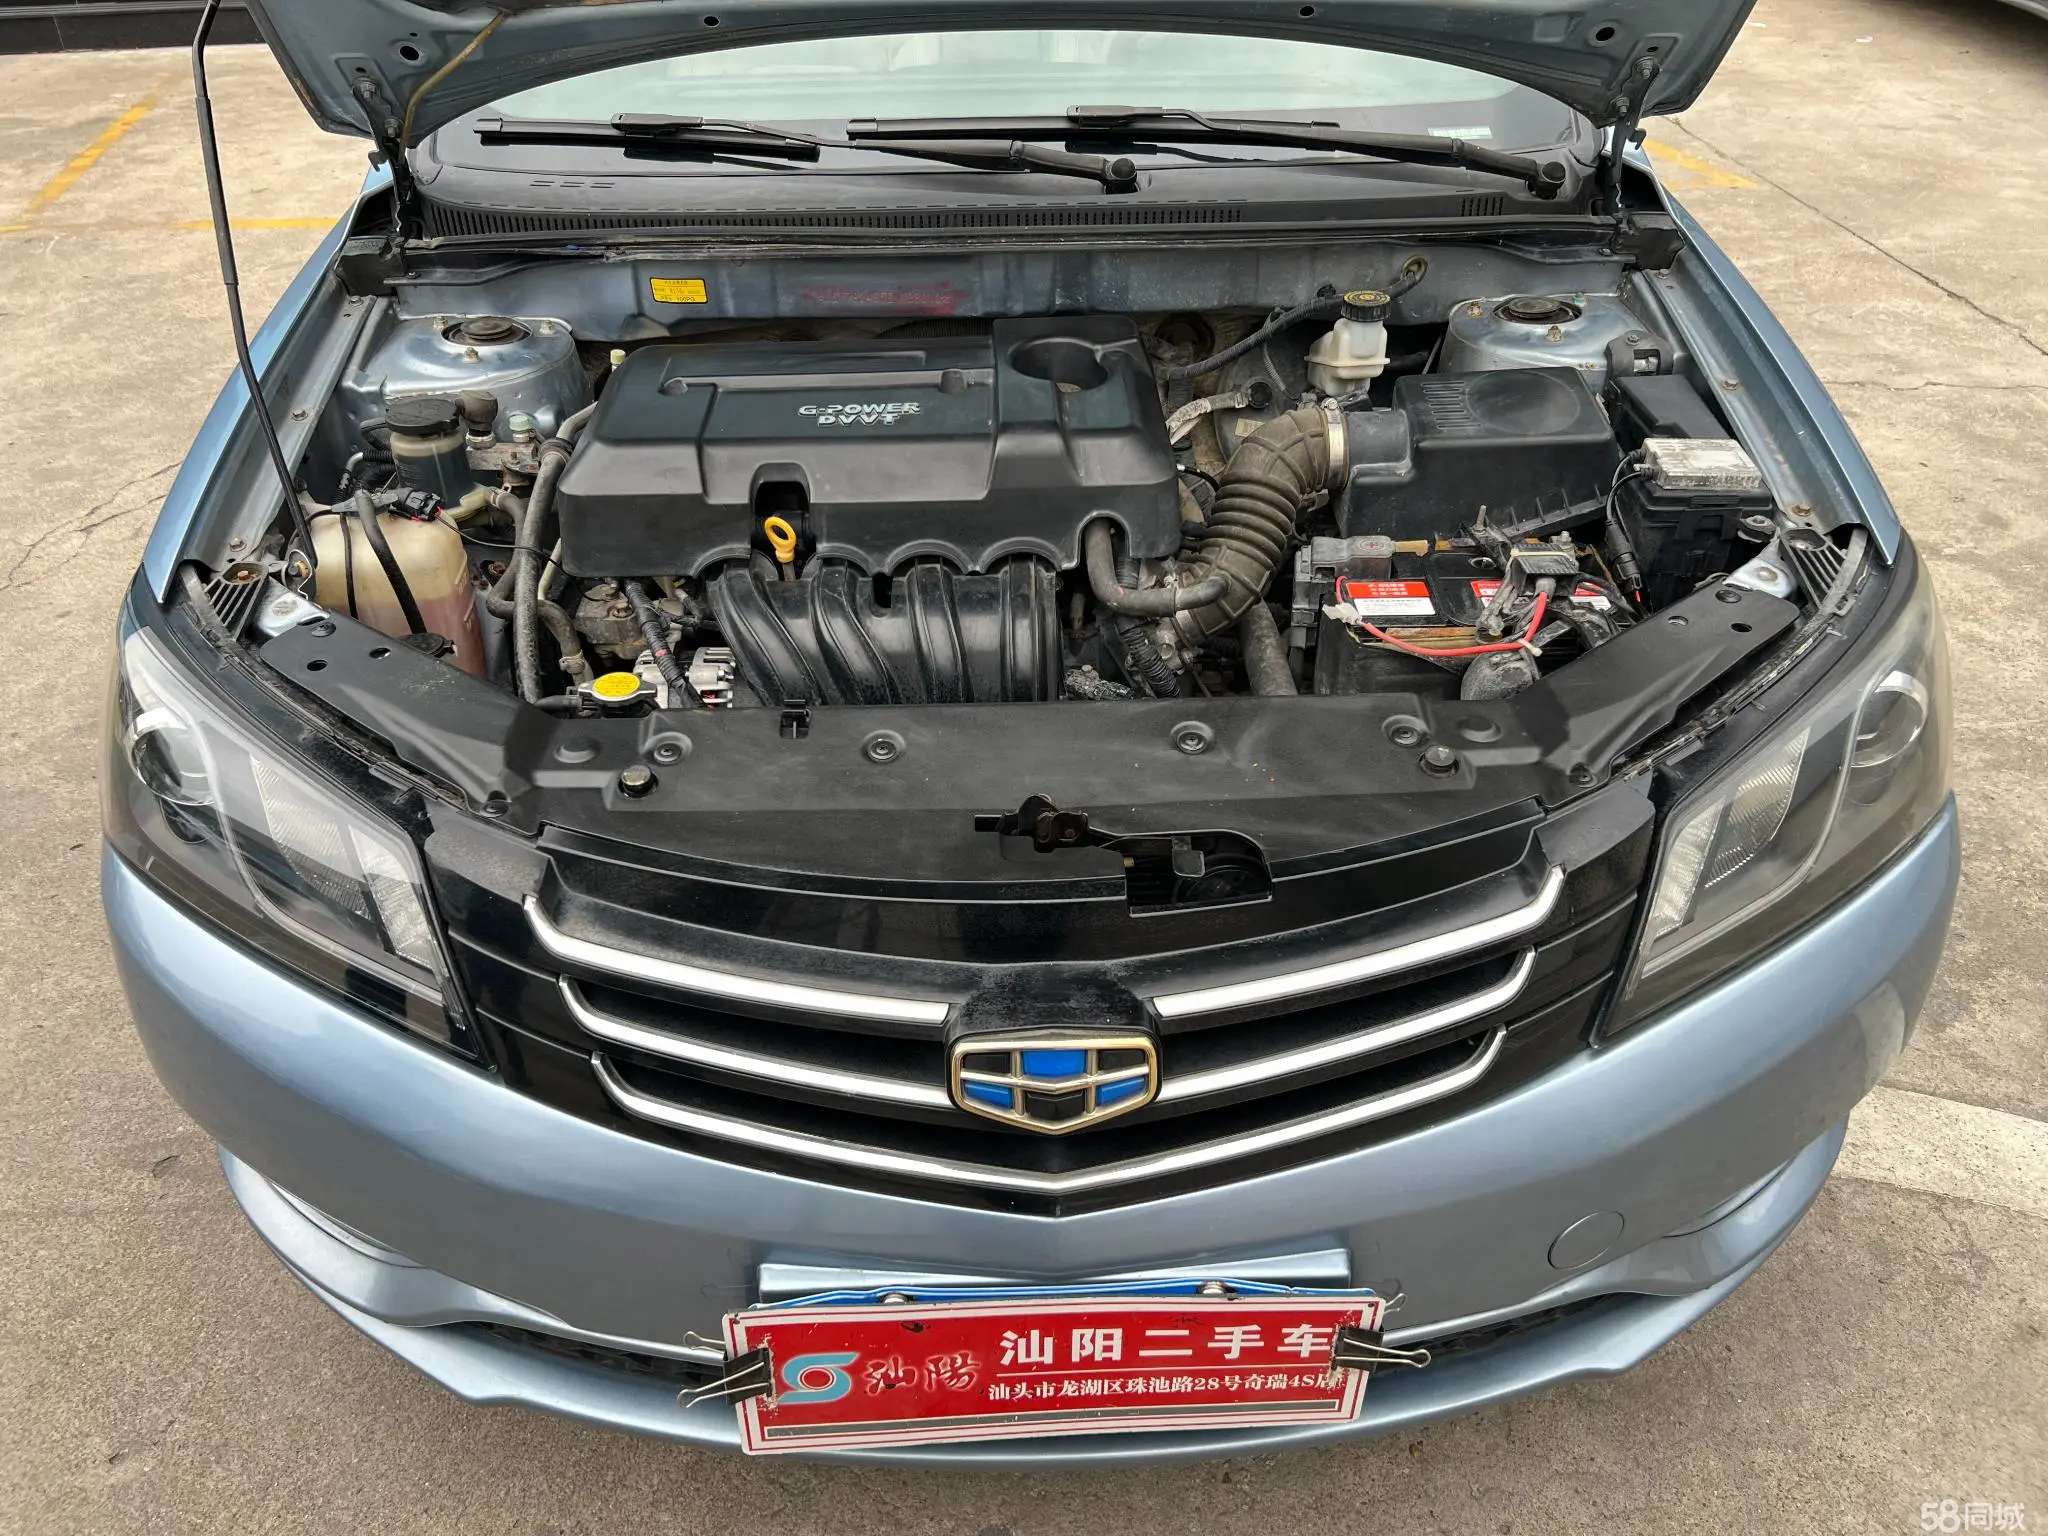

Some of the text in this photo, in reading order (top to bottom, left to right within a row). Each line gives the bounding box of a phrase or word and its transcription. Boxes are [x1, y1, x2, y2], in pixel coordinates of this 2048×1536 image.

[798, 402, 921, 416] G-POWER
[817, 414, 900, 426] DVVT
[999, 1323, 1333, 1366] 汕阳二手车
